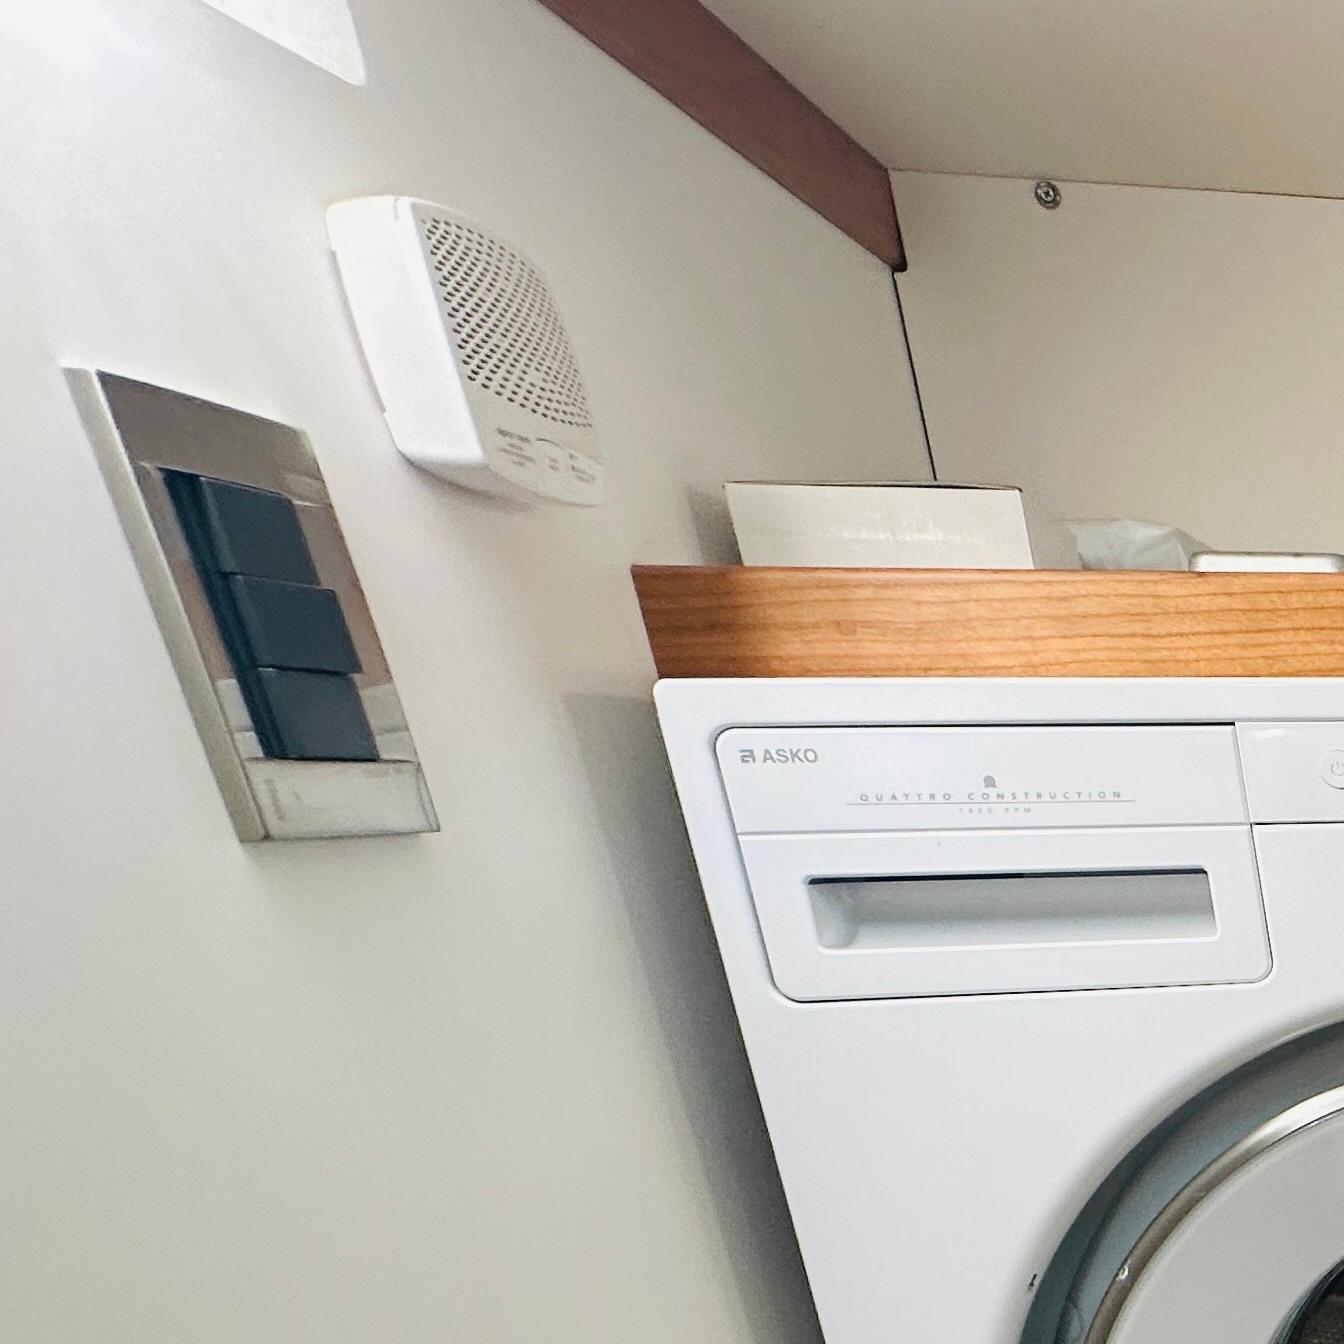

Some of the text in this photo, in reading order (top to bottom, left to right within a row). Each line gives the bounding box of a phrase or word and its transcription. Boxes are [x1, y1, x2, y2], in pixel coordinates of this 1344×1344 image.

[761, 747, 820, 764] ASKO
[859, 791, 1122, 802] QUATTRO CONSTRUCTION
